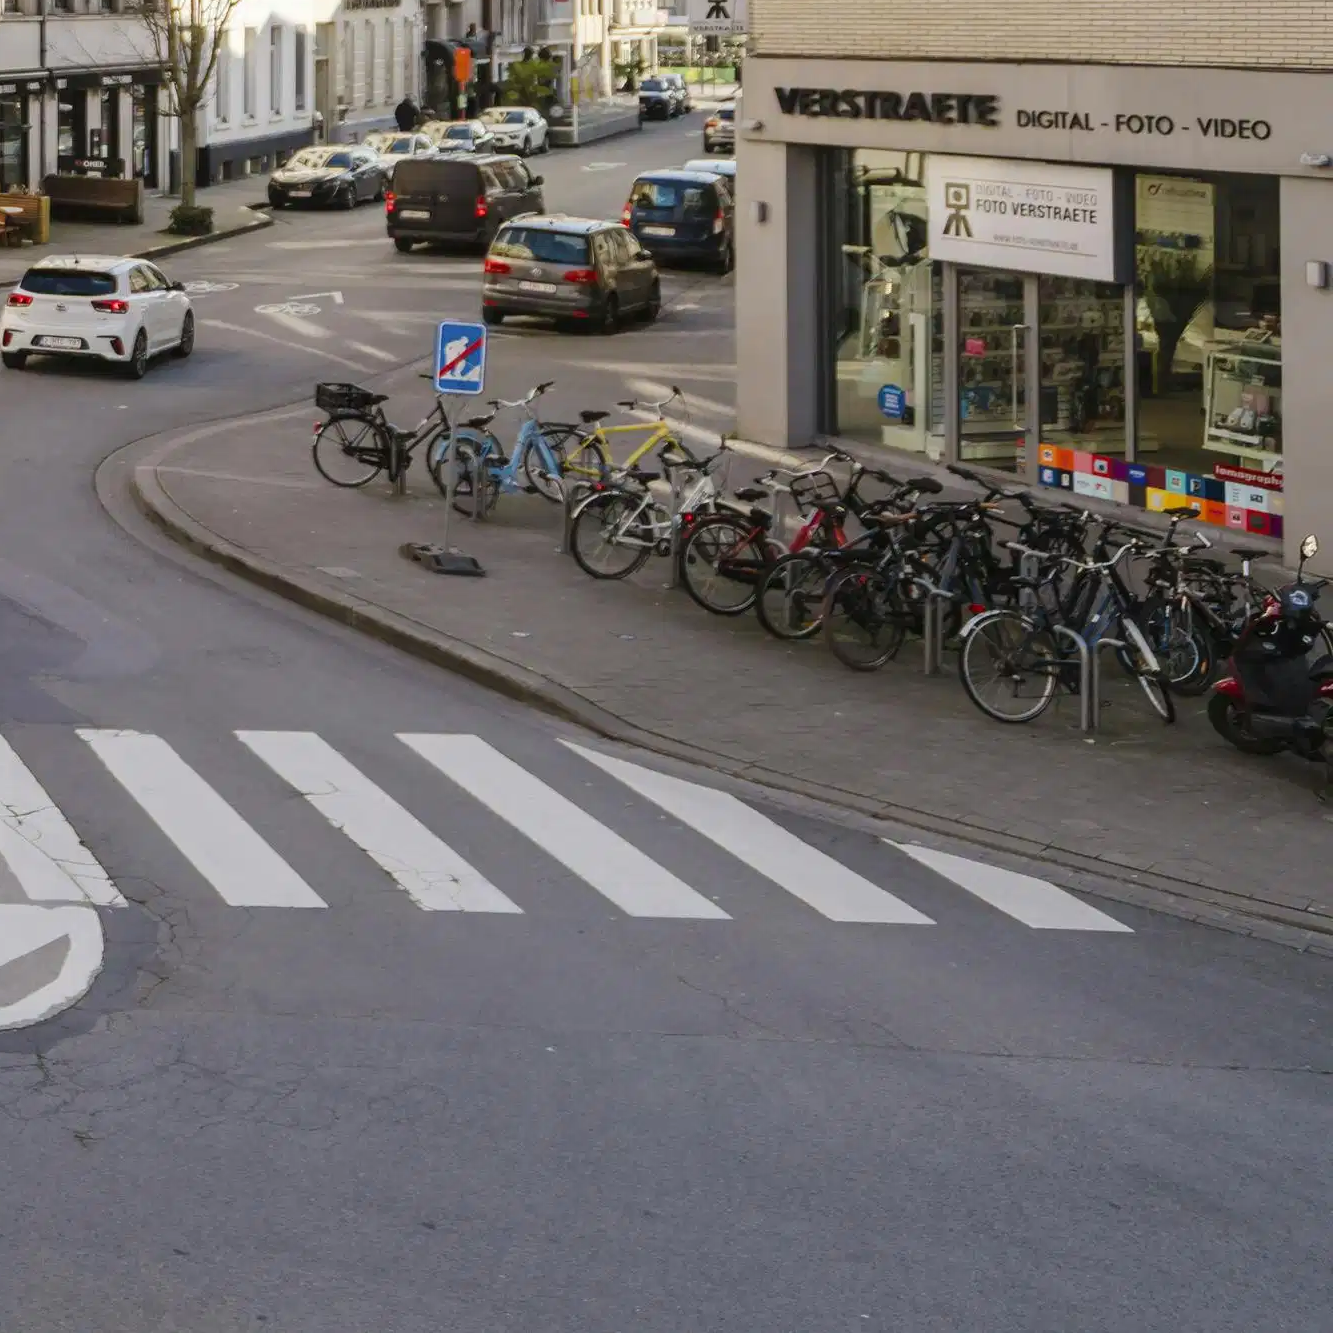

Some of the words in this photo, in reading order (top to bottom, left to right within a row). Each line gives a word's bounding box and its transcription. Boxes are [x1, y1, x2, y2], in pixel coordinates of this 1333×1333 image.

[774, 87, 1002, 127] VERSTRAETE
[1016, 109, 1095, 131] DIGITAL
[1115, 113, 1174, 136] FOTO
[1197, 117, 1272, 140] VIDEO
[975, 184, 1014, 199] DIGITAL
[1025, 188, 1054, 203] FOTO
[1065, 191, 1098, 207] VIDEO
[975, 198, 1007, 215] FOTO
[1012, 202, 1098, 224] VERSTRAETE
